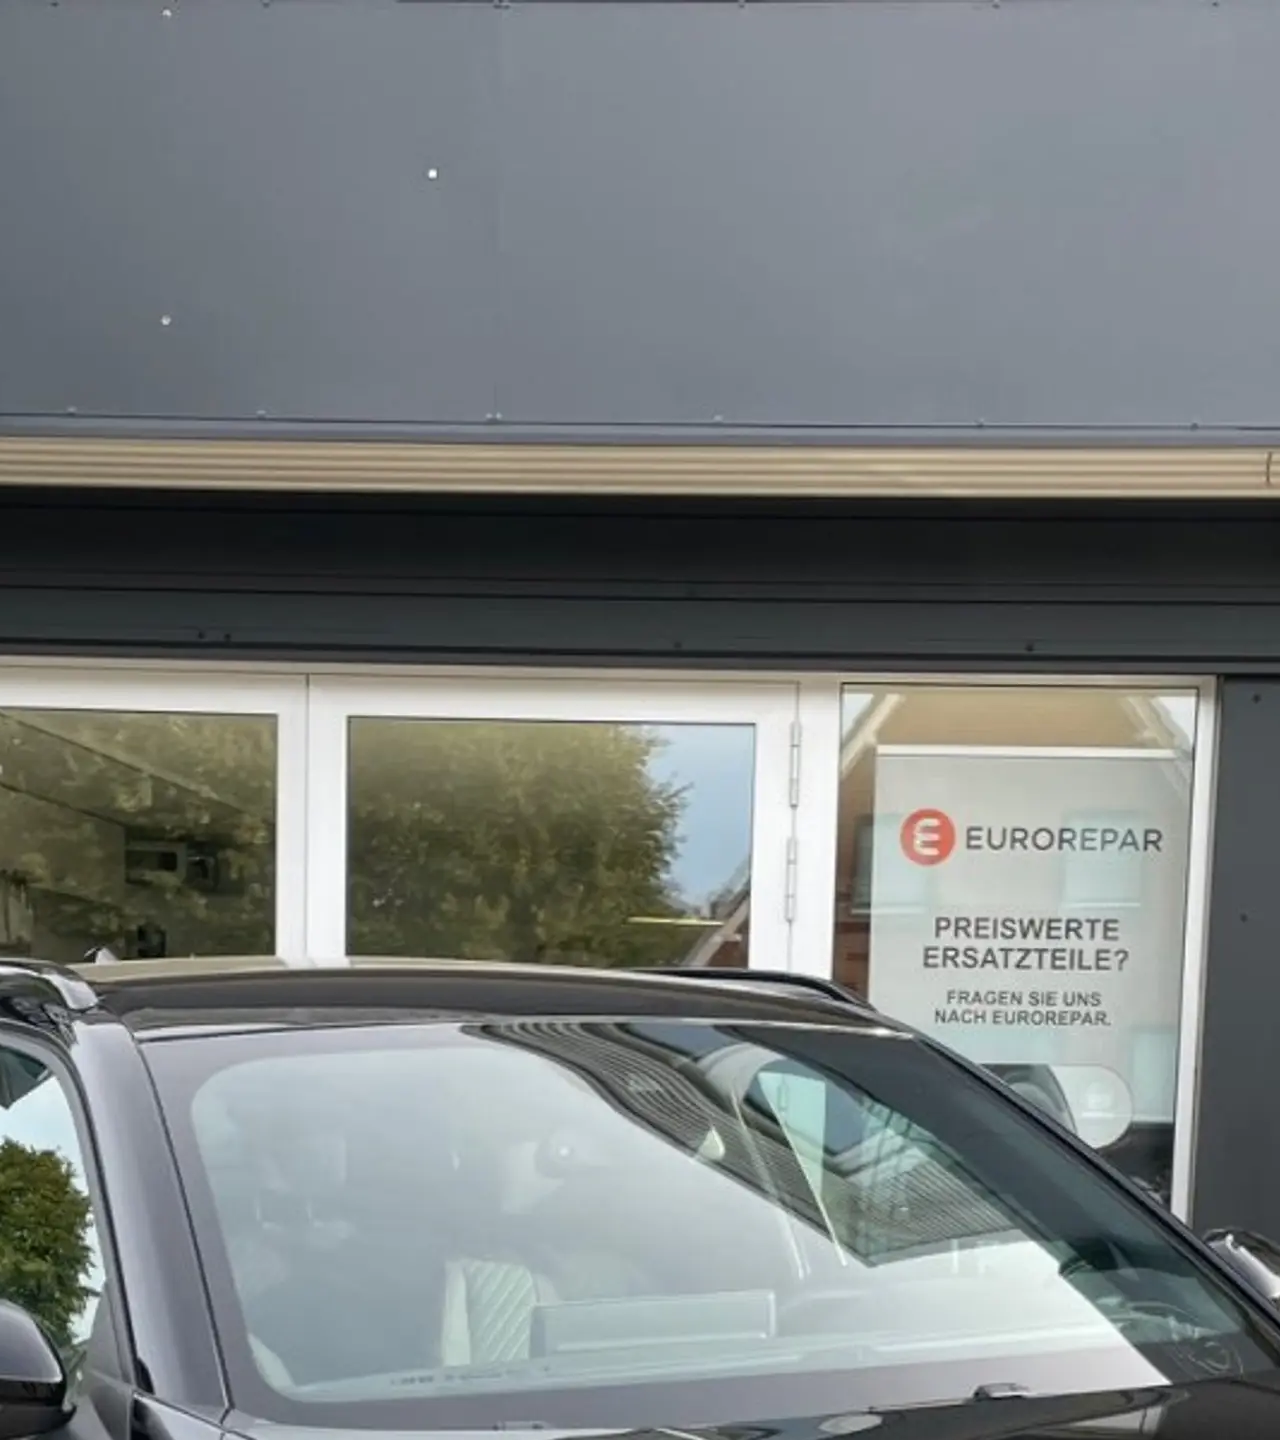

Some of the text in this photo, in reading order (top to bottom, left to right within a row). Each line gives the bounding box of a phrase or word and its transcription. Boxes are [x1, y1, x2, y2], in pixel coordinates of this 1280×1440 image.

[965, 826, 1163, 853] EUROREPAR
[934, 917, 1120, 942] PREISWERTE
[923, 946, 1129, 972] ERSATZTEILE?
[946, 990, 1102, 1008] FRAGEN SIE UNS
[934, 1009, 1112, 1027] NACH EUROREPAR.
